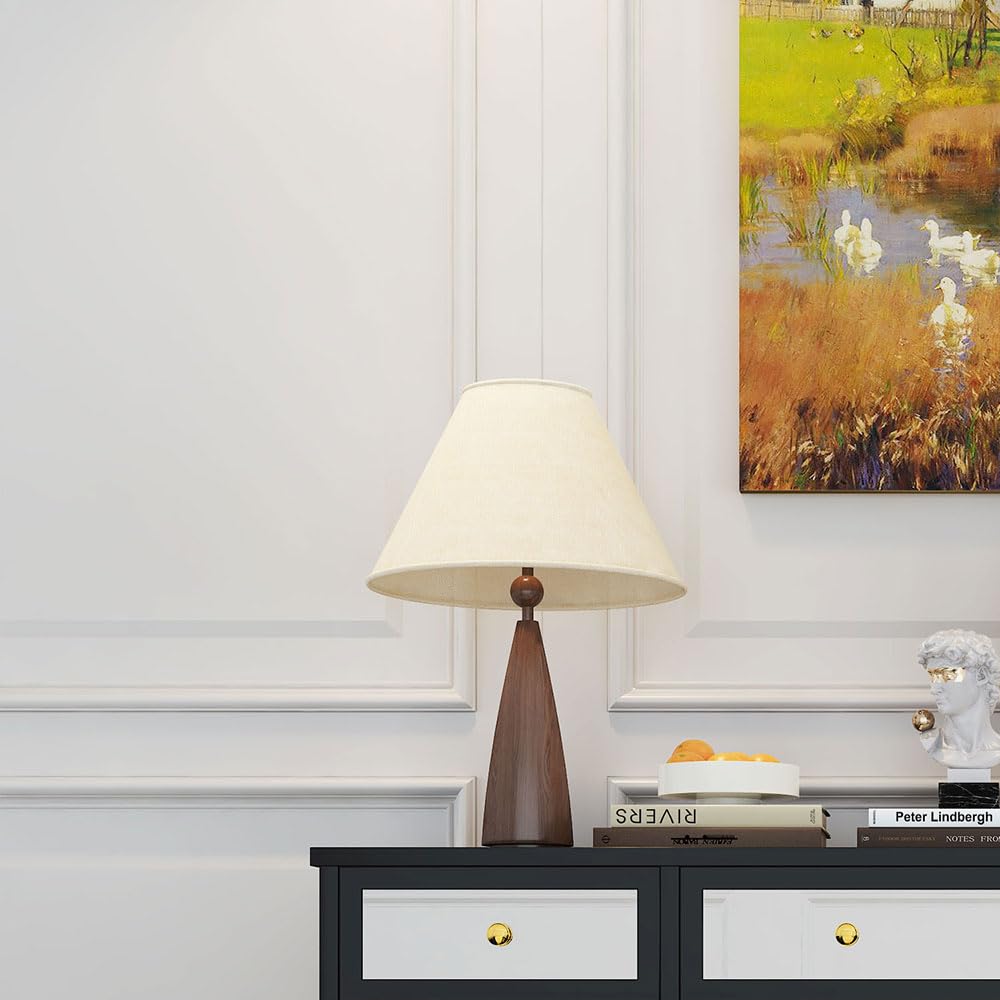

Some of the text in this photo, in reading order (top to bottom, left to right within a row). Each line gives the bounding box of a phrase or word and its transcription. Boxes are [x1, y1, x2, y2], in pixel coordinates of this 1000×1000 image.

[615, 808, 697, 824] RIVERS
[895, 811, 993, 825] Peter Lindbergh
[945, 835, 975, 843] NOTES
